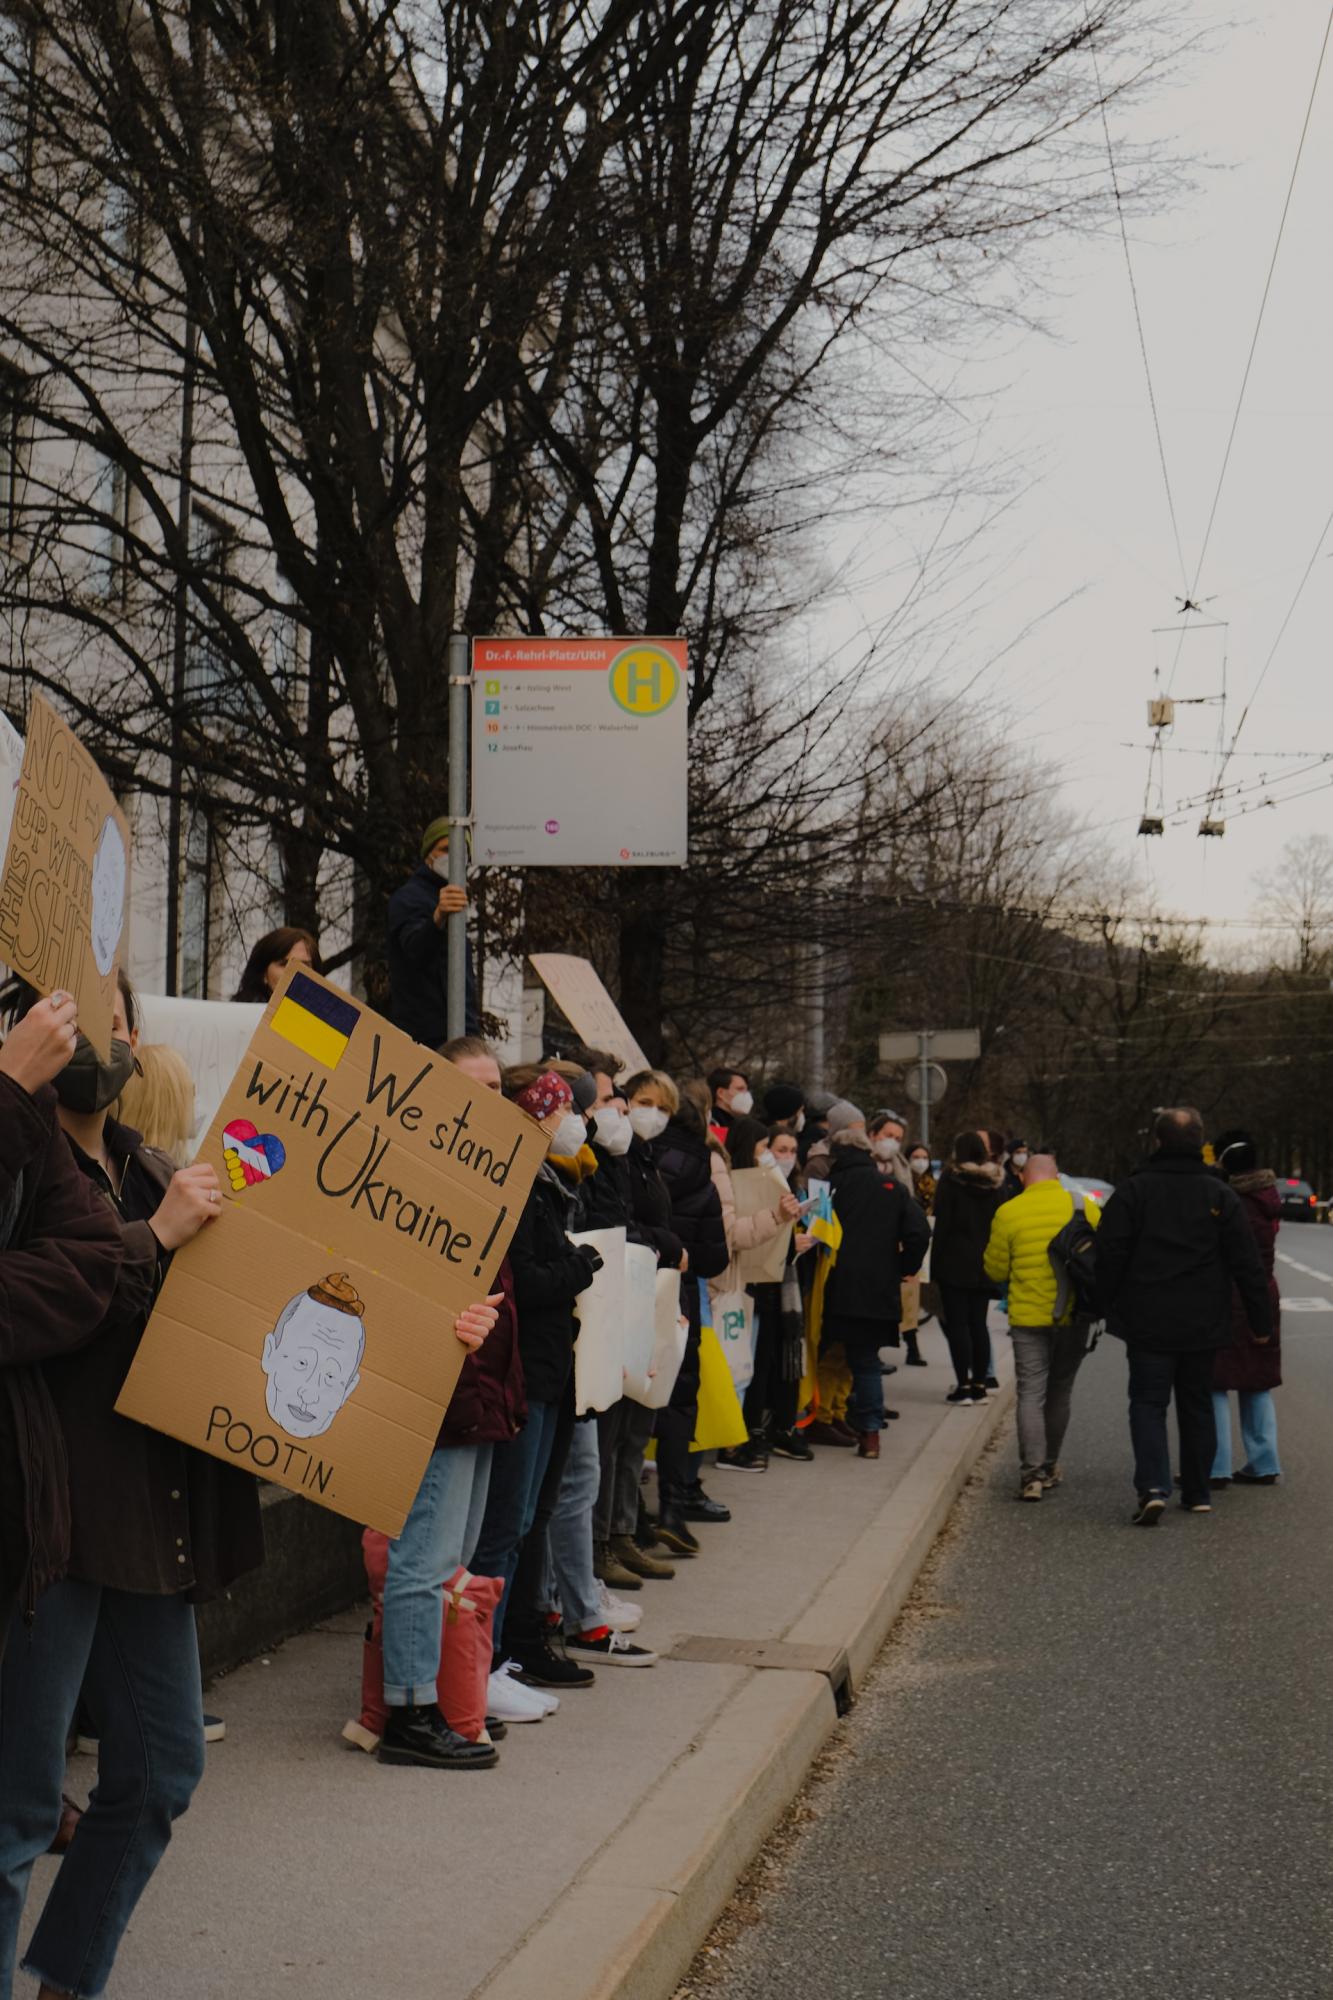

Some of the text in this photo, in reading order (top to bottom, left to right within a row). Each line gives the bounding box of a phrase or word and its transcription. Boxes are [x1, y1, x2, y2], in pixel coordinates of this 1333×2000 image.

[487, 723, 498, 732] 10
[488, 682, 496, 693] 6
[488, 703, 497, 713] 7
[627, 662, 661, 704] H
[23, 698, 92, 833] NOT
[487, 743, 498, 752] 12
[0, 845, 31, 951] THIS
[16, 788, 92, 914] UP WITH
[12, 868, 92, 1020] SHIT
[366, 1033, 523, 1187] We stand
[246, 1061, 507, 1277] with Ukraine!
[206, 1405, 336, 1498] POOTIN.
